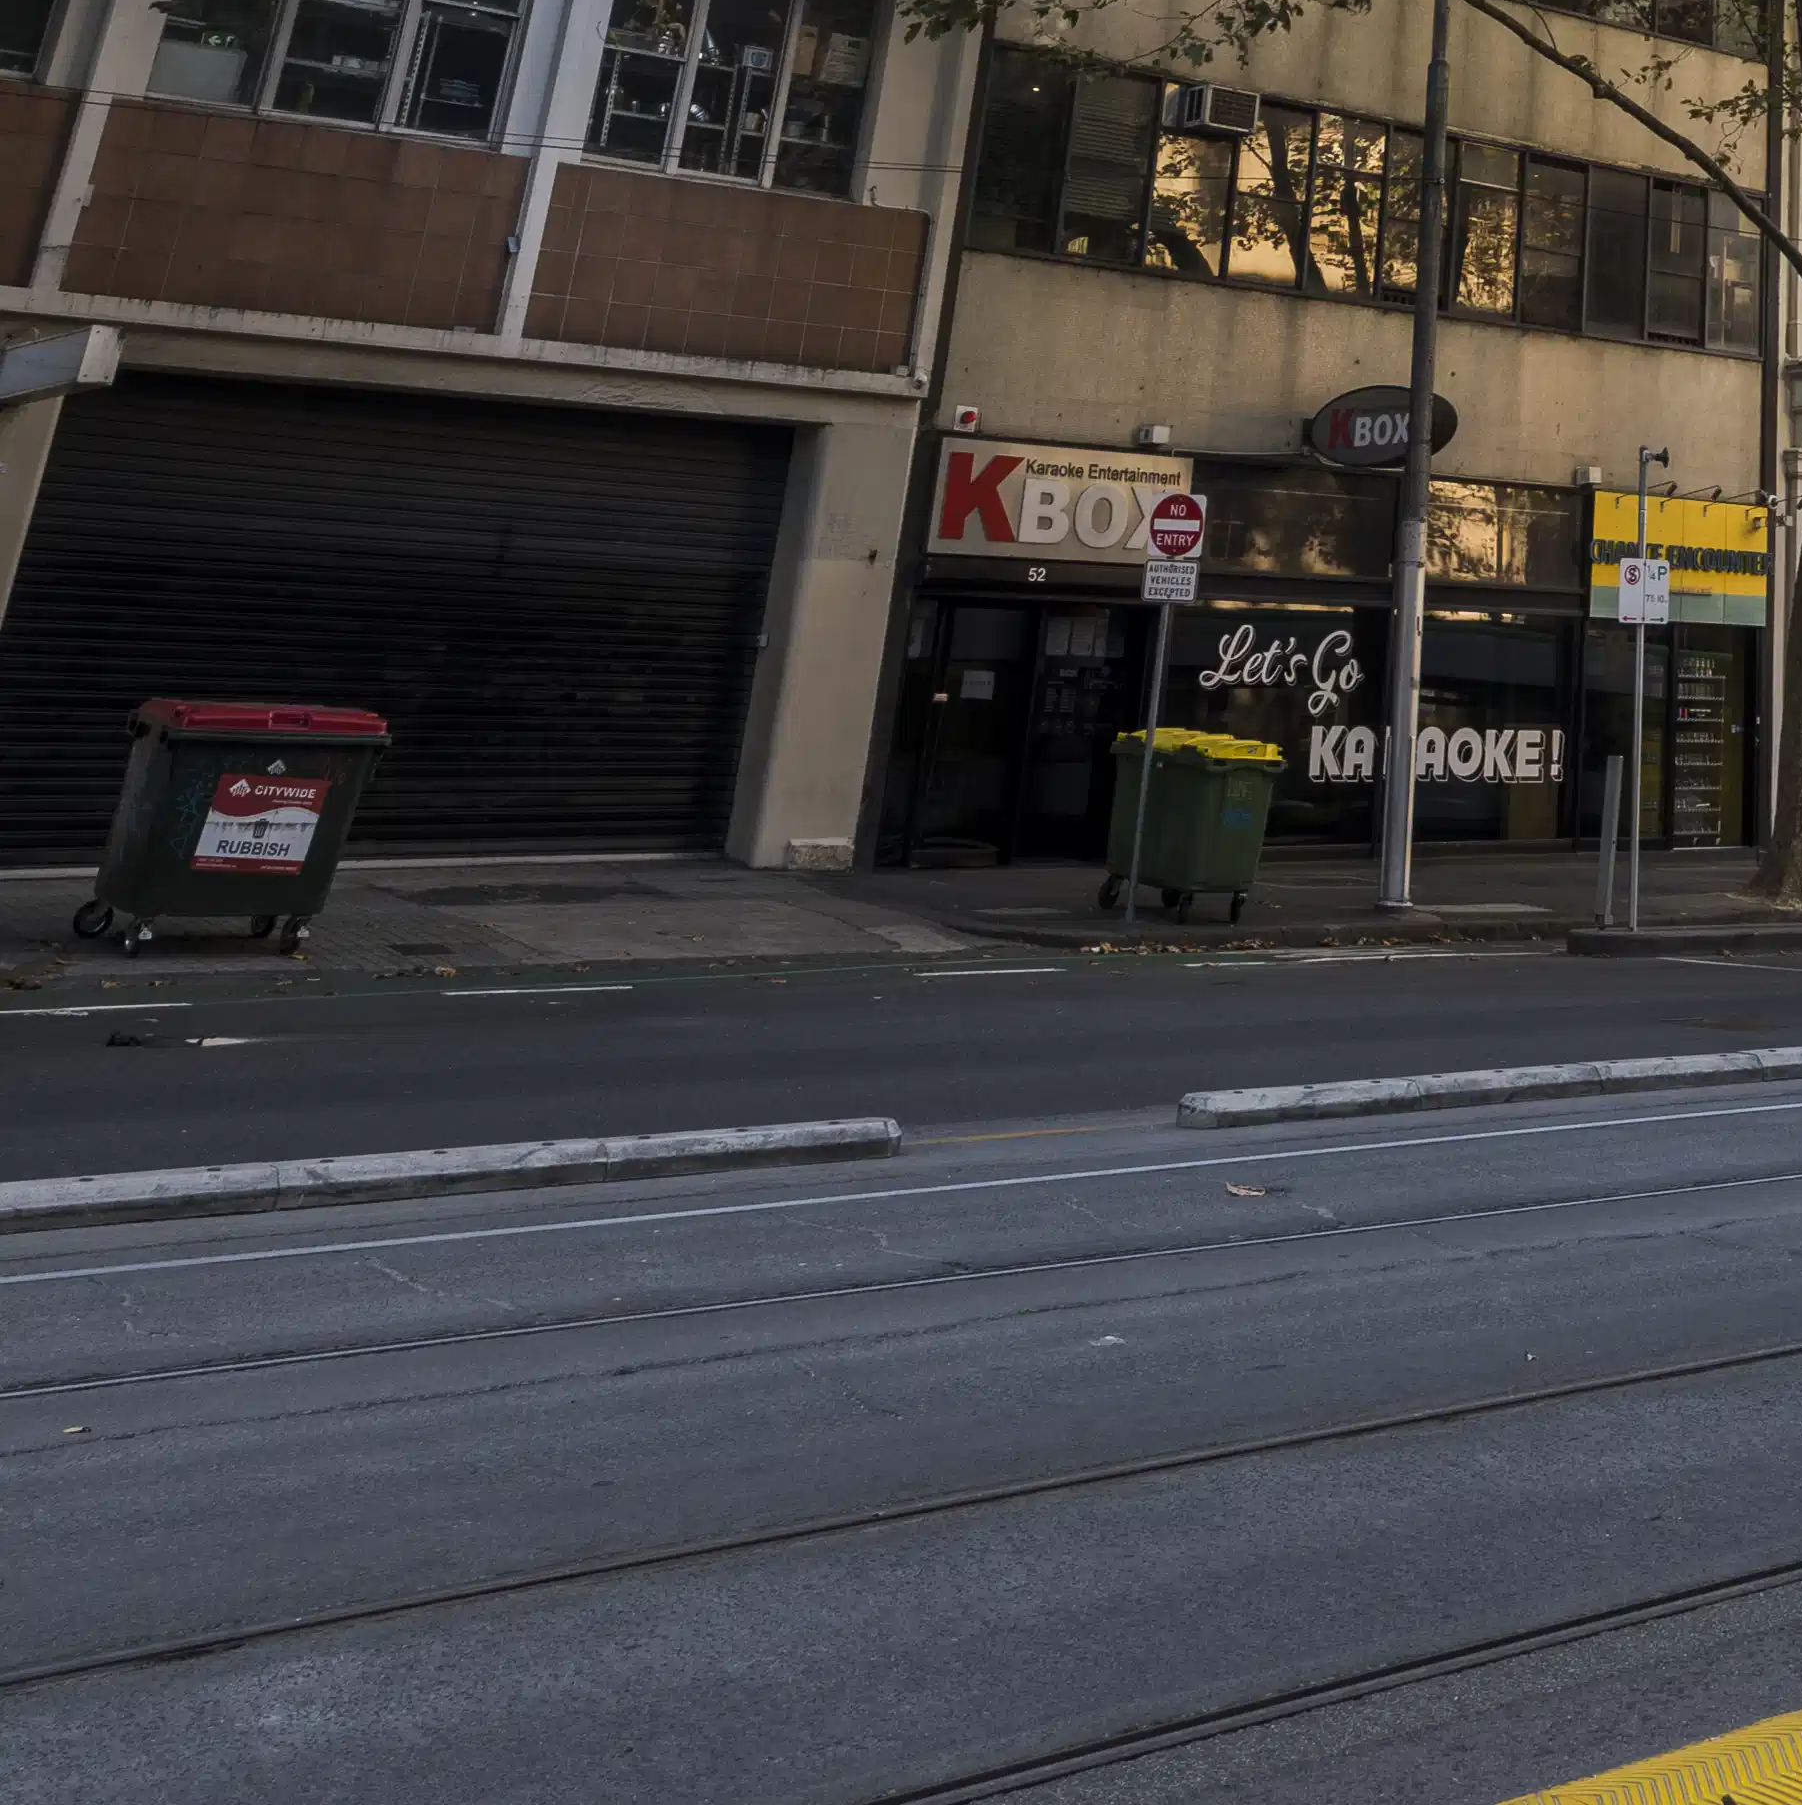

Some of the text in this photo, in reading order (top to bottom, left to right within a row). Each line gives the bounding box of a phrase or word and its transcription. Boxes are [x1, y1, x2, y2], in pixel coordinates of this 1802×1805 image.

[1328, 408, 1410, 450] KBOX
[1025, 459, 1181, 486] Karaoke Entertainment
[1170, 504, 1187, 517] NO
[1156, 533, 1195, 546] ENTRY
[1667, 544, 1774, 576] ENCOUNTER
[1027, 567, 1047, 582] 52
[1148, 563, 1195, 576] AUTHORISED
[1150, 575, 1192, 586] VEHICLES
[1148, 587, 1191, 598] EXCEPTED
[1198, 624, 1366, 717] Let's Go
[253, 784, 317, 799] CITYWIDE
[216, 839, 291, 857] RUBBISH
